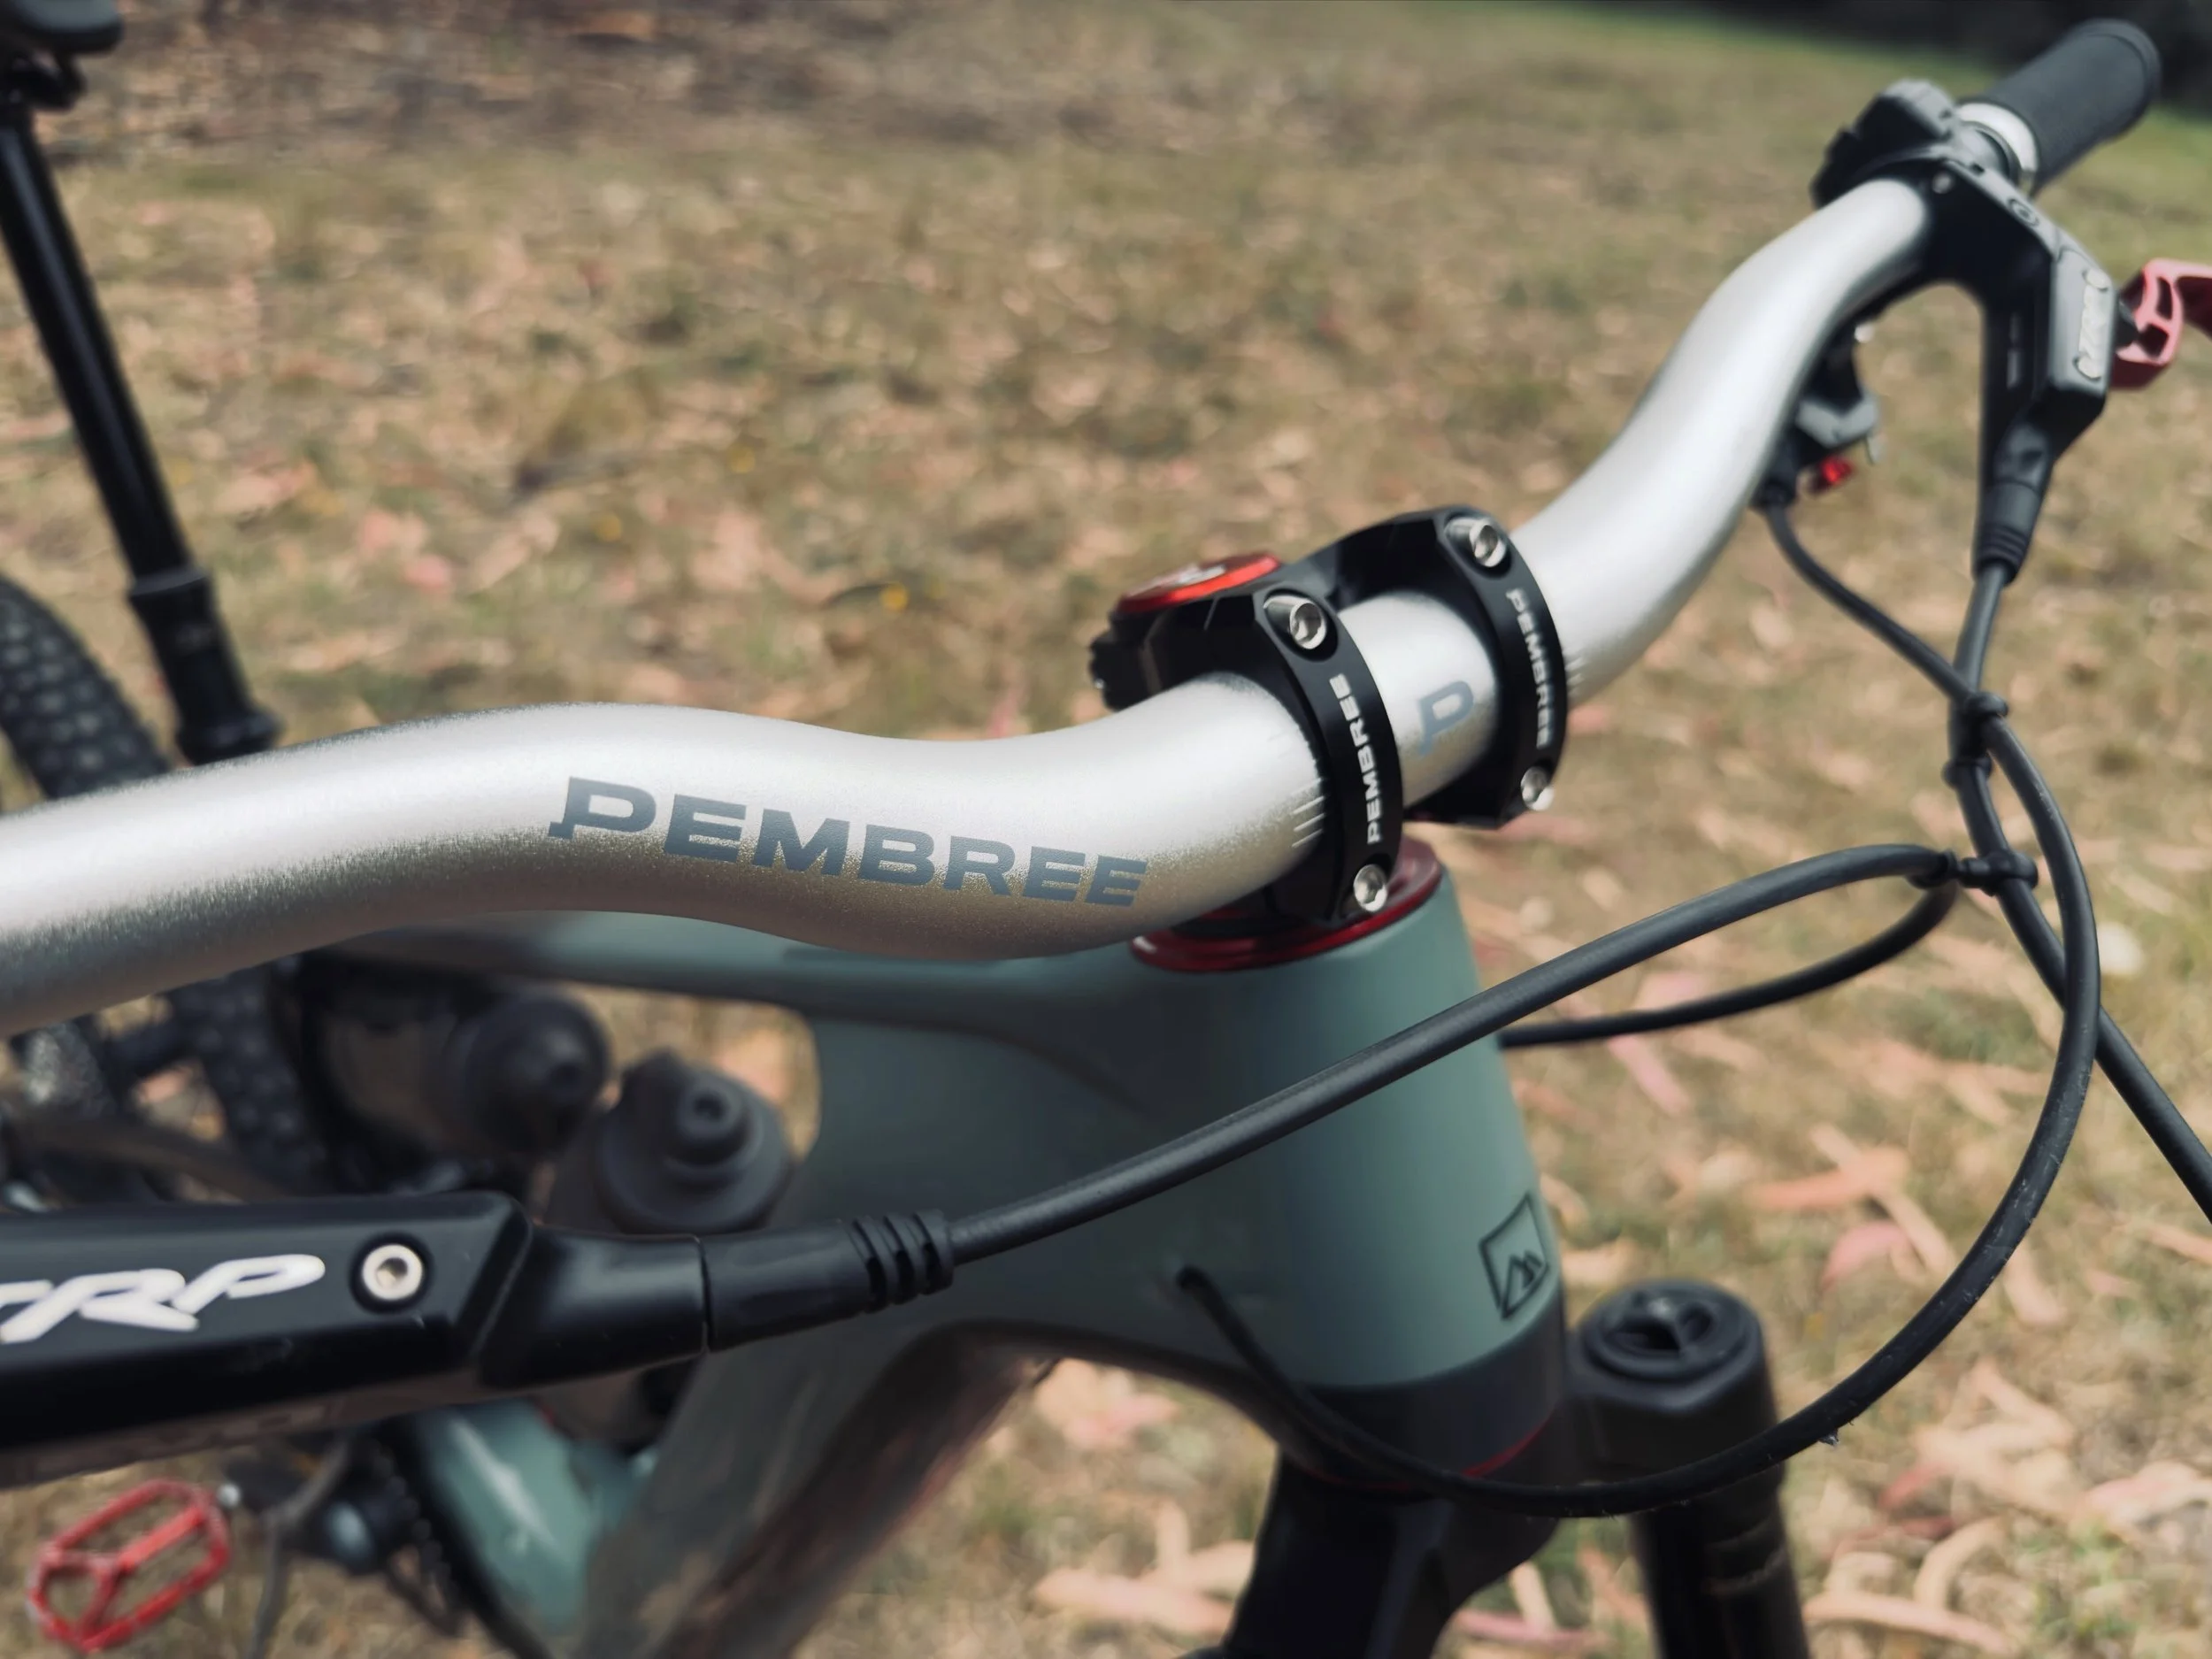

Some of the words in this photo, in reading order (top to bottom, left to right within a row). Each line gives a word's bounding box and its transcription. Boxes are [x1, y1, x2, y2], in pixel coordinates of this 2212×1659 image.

[1419, 680, 1474, 757] P
[1505, 588, 1551, 749] PEMBREE
[1329, 672, 1382, 844] PEMBREE
[548, 777, 1148, 907] PEMBREE
